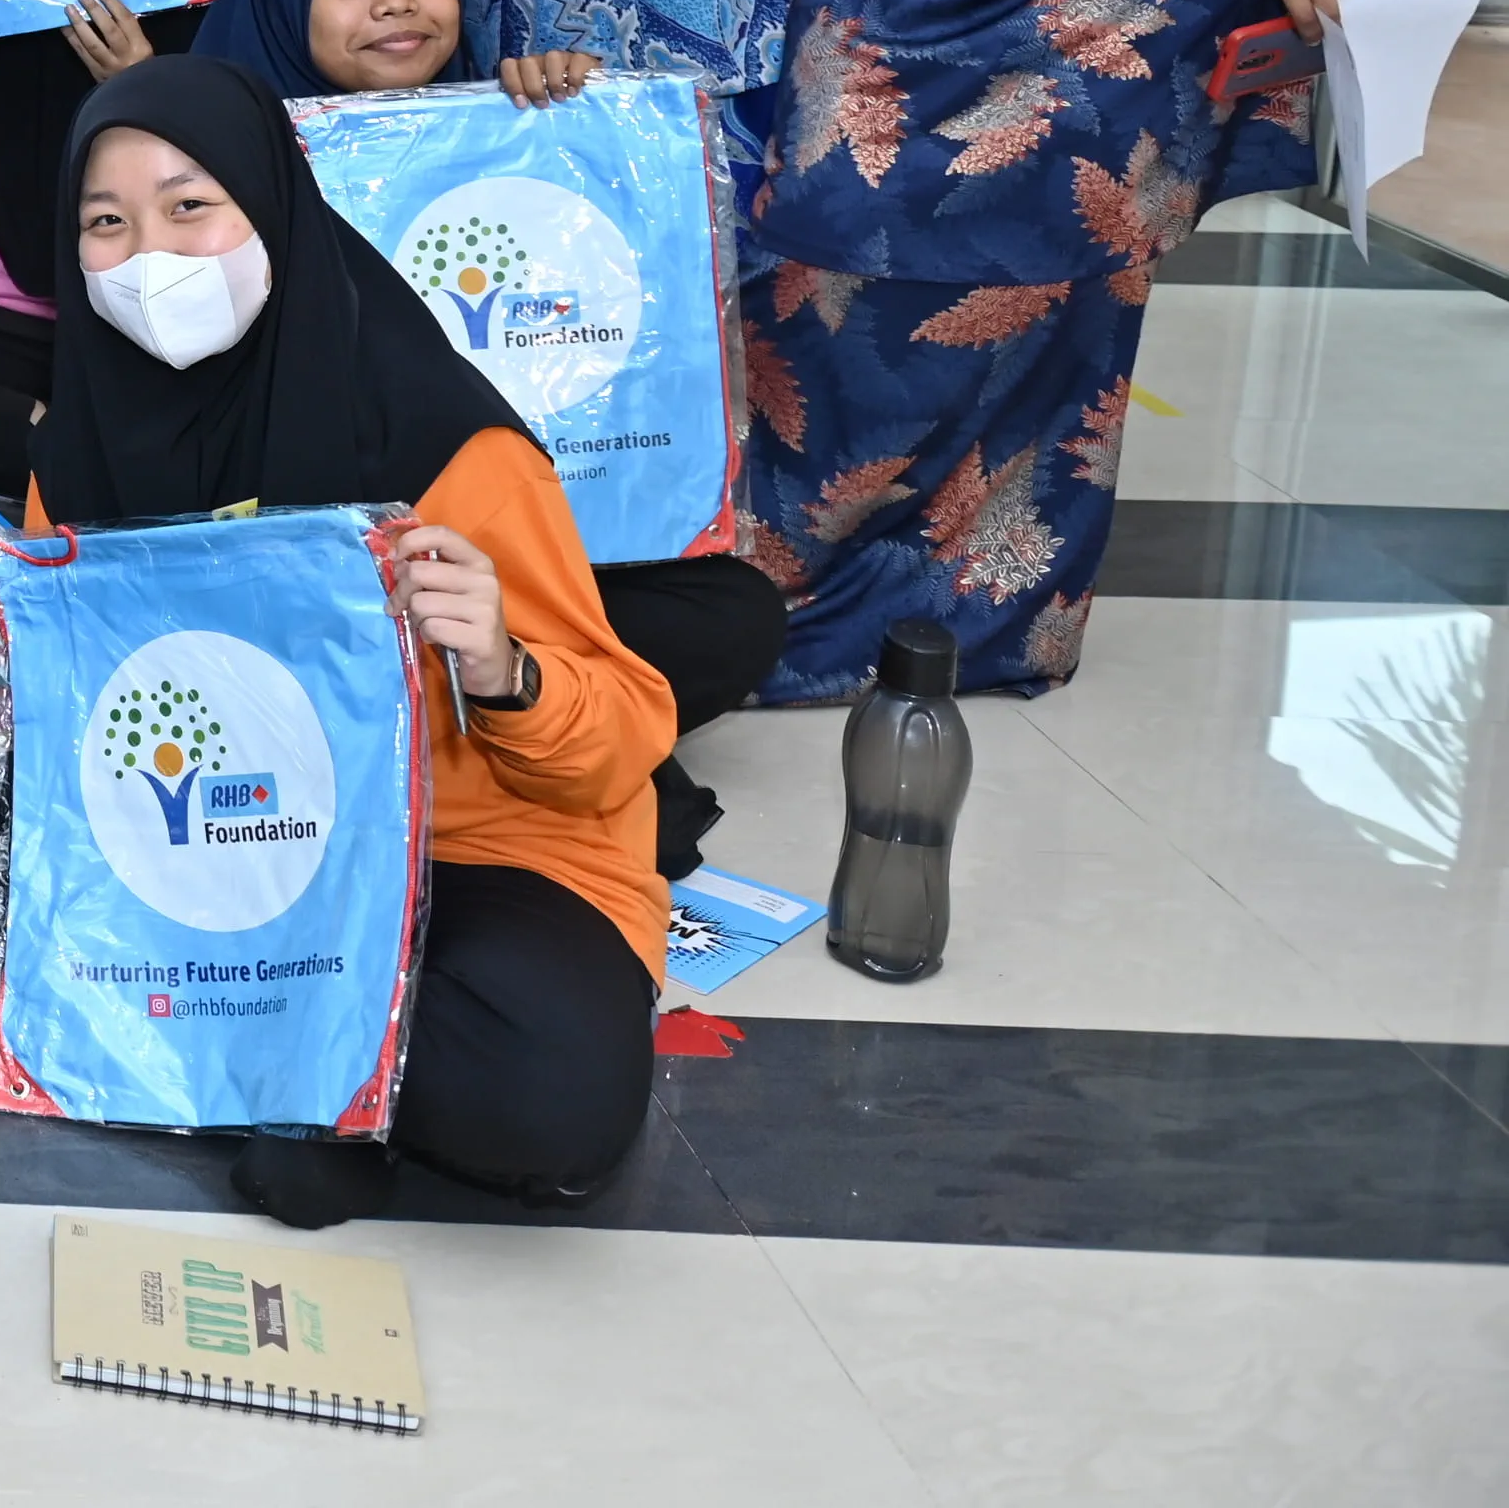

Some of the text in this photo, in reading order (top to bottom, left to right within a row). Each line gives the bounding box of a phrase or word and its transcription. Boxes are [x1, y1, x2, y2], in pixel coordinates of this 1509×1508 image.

[555, 431, 671, 455] Generations
[211, 783, 251, 809] RHB
[204, 816, 317, 845] Foundation
[69, 953, 344, 988] Nurturing Future Generations
[172, 995, 287, 1020] @rhbfoundation
